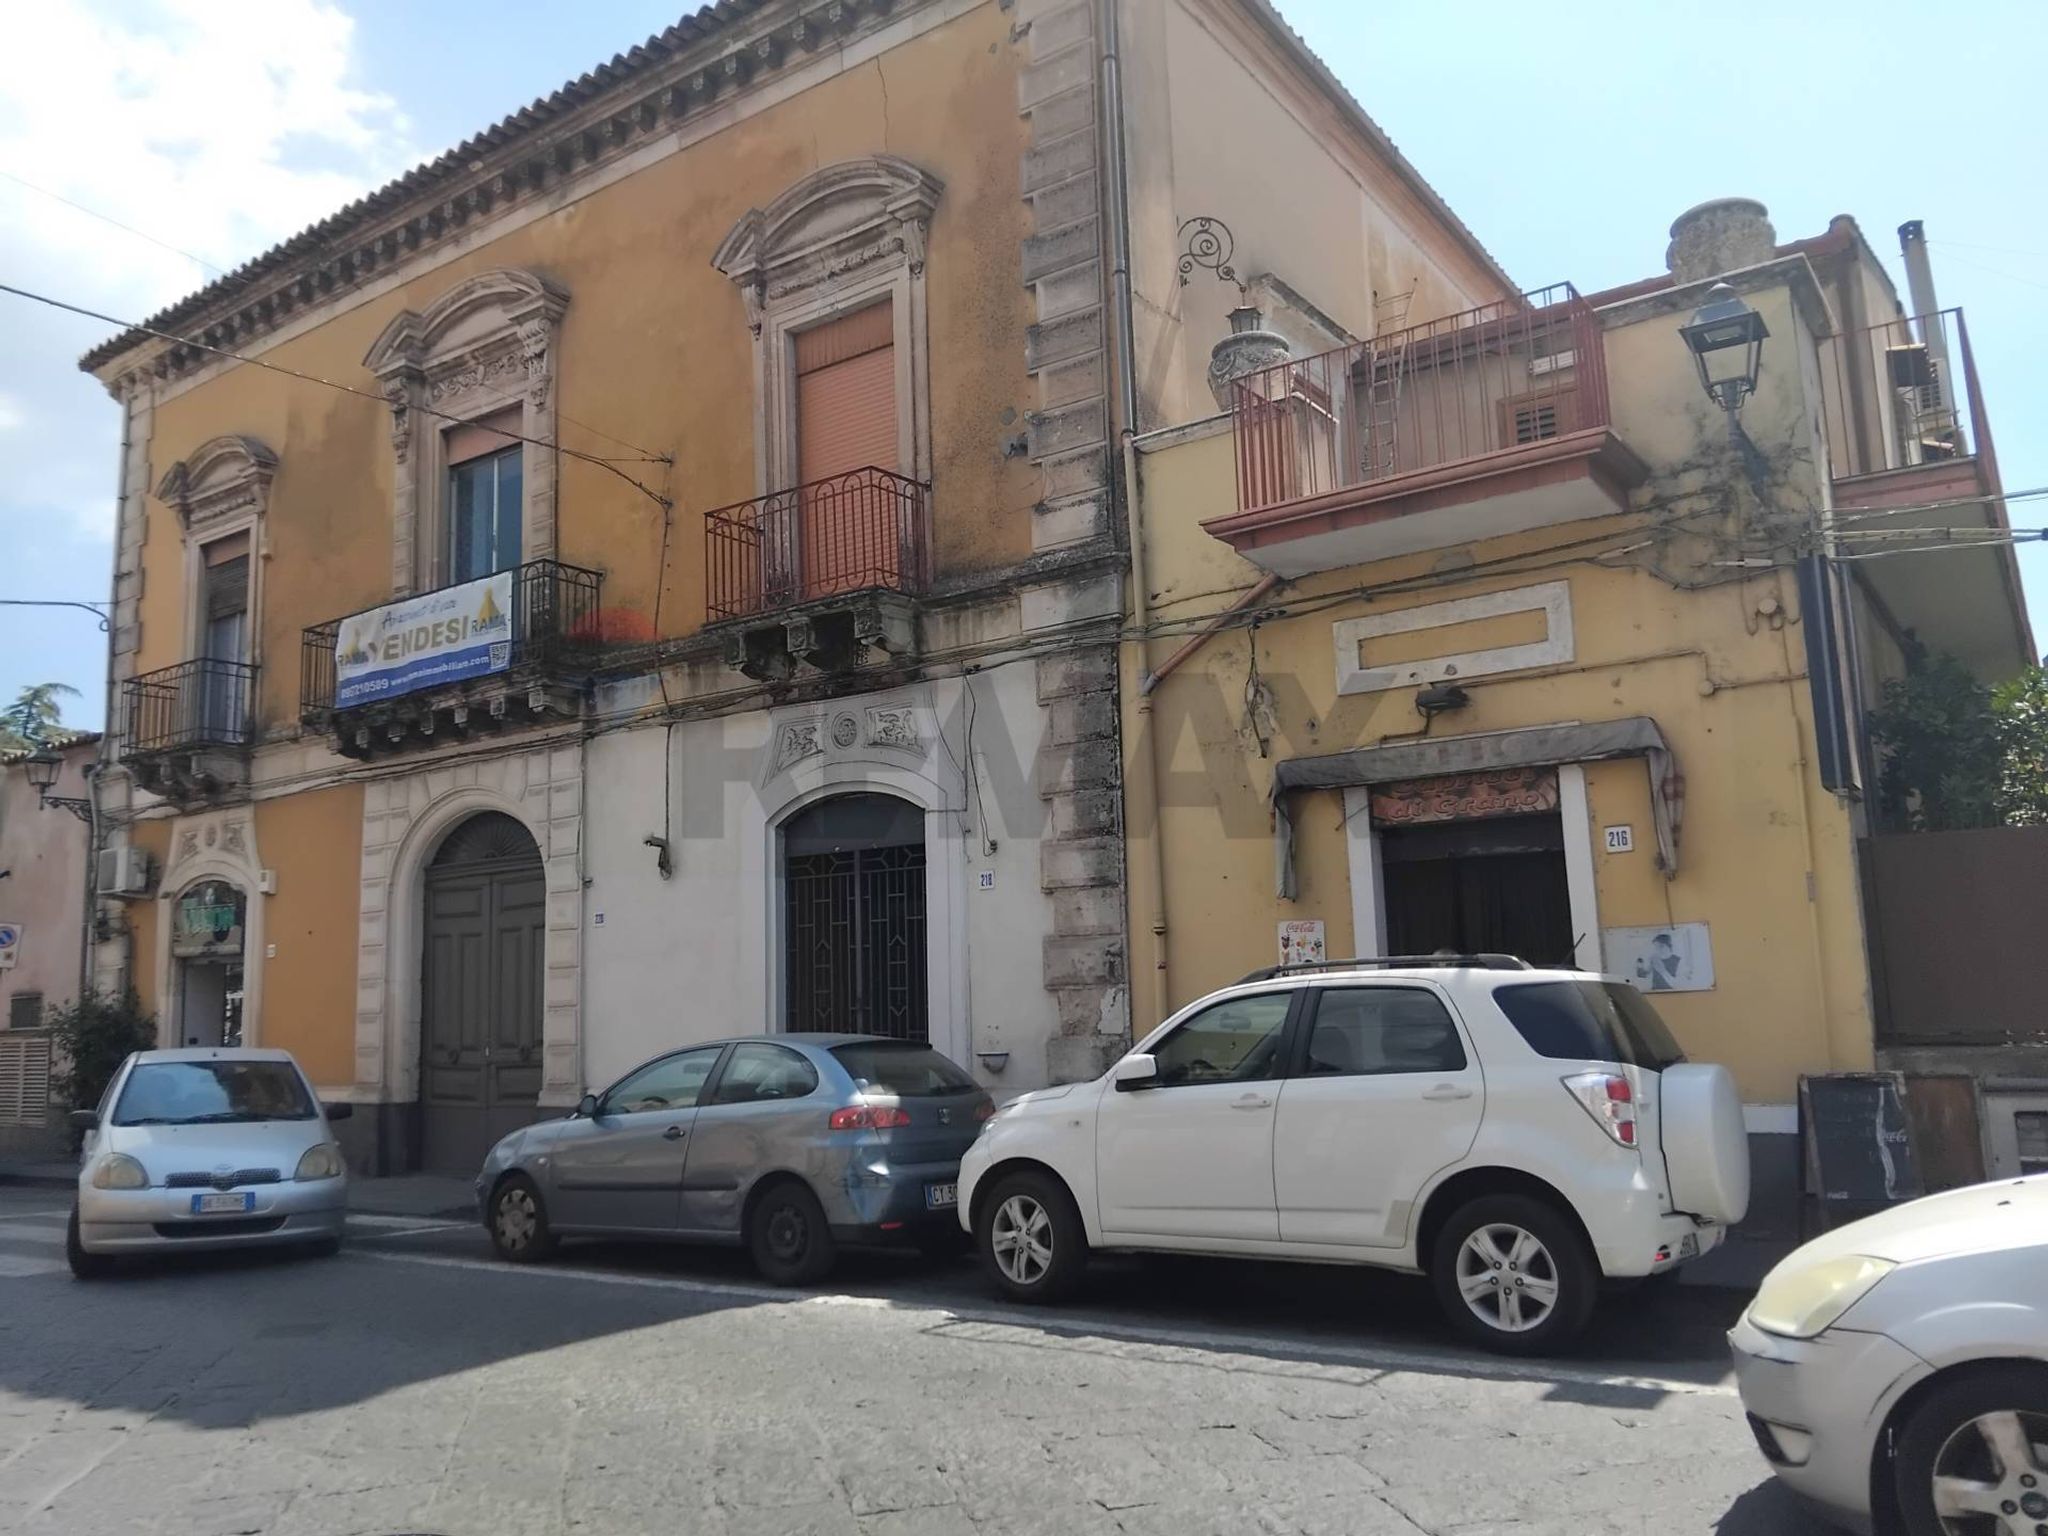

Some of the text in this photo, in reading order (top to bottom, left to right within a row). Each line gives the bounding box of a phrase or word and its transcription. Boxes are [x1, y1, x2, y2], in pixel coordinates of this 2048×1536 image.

[367, 614, 468, 662] VENDESI
[1387, 790, 1541, 820] di Grano
[1608, 830, 1628, 847] 216
